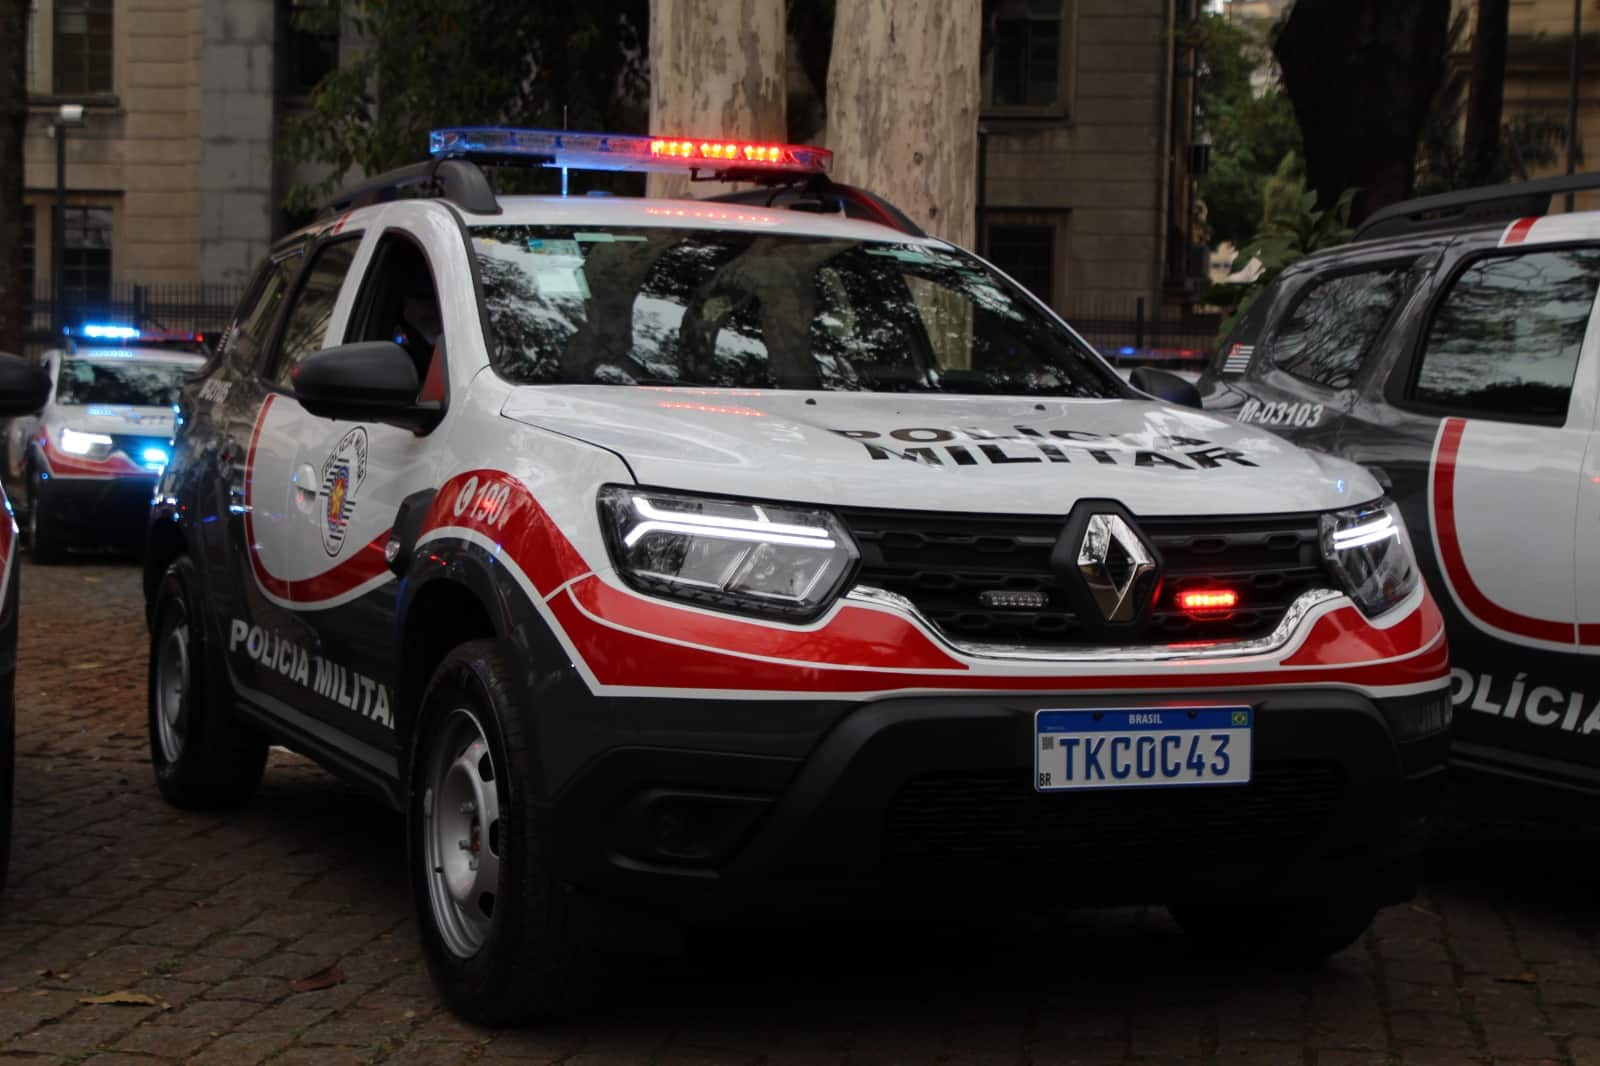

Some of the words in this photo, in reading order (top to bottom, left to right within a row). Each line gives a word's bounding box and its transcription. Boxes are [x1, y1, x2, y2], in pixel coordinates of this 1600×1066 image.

[1236, 398, 1324, 428] M-03103
[827, 424, 1211, 447] POLÍCA
[862, 442, 1260, 471] MILITAR
[470, 480, 510, 525] 190
[229, 618, 310, 688] POLÍCIA
[312, 655, 396, 730] MILITA
[1128, 713, 1163, 725] BRASIL
[1058, 733, 1232, 781] TKC0C43
[1039, 772, 1052, 787] BR
